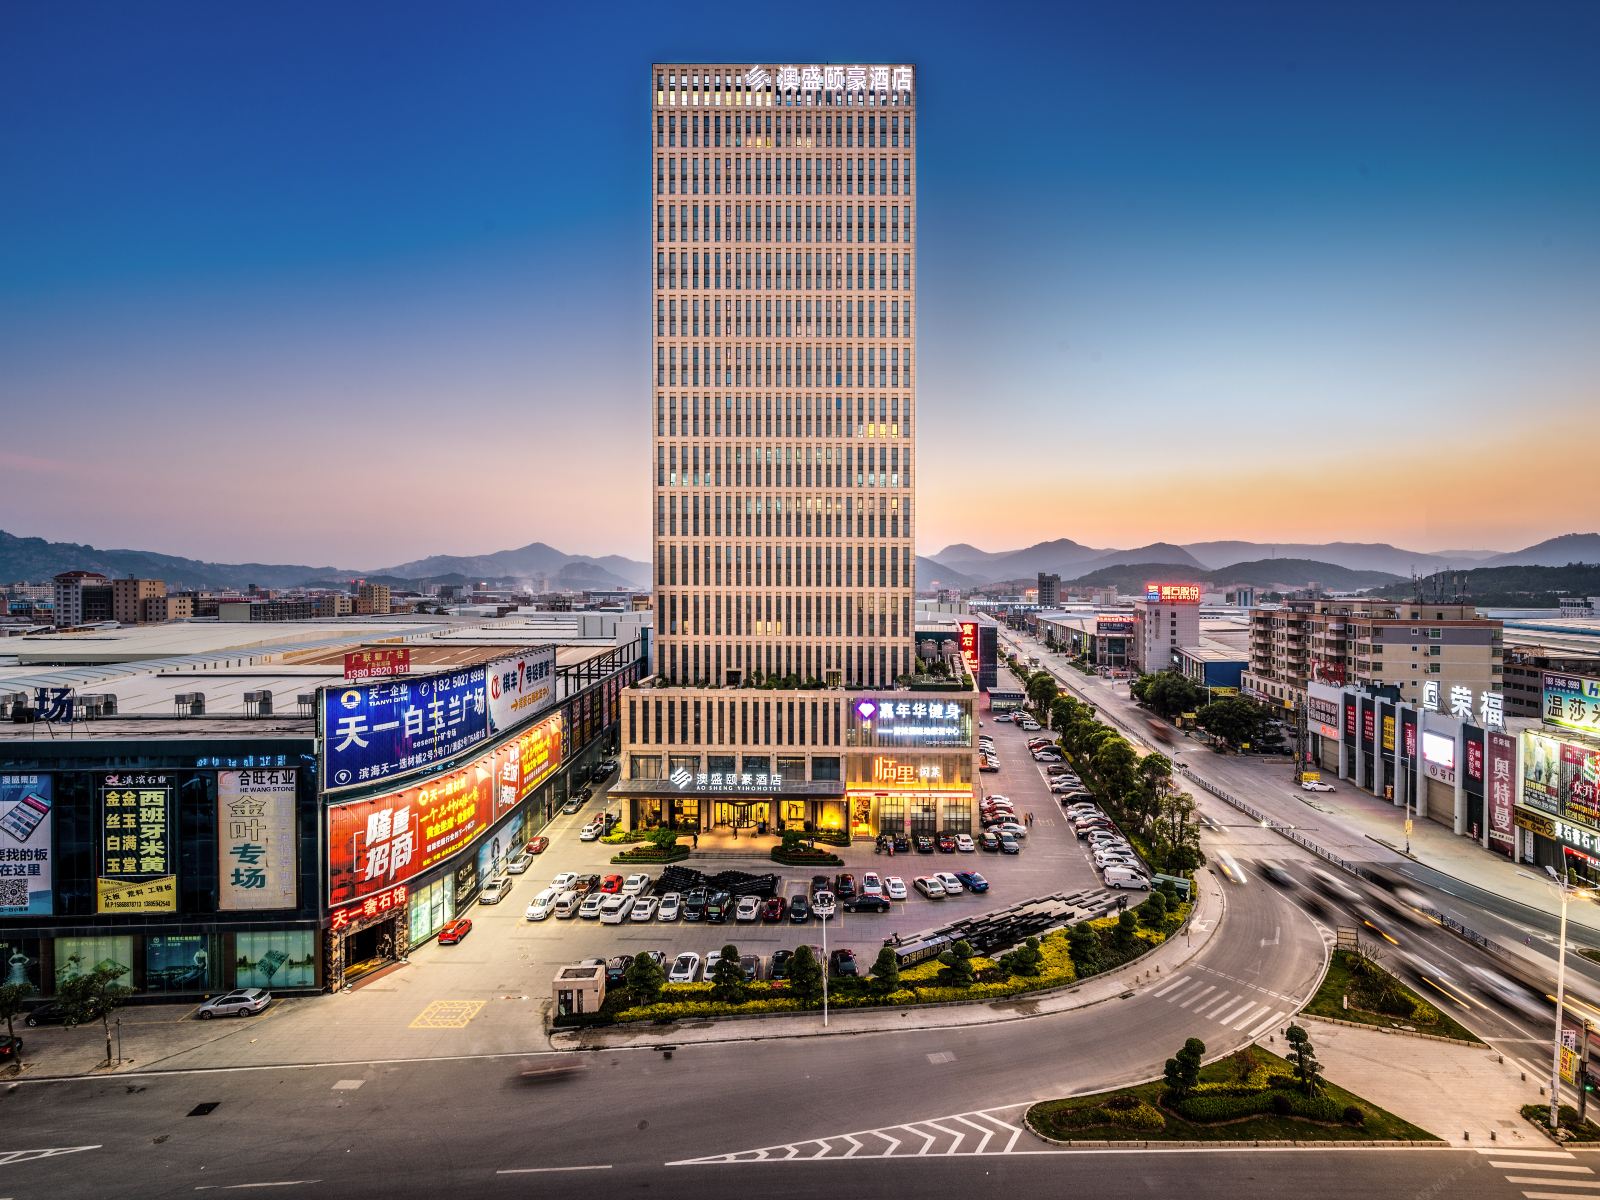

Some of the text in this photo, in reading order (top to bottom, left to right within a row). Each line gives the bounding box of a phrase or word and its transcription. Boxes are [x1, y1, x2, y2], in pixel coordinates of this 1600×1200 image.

[778, 65, 913, 92] 澳盛颐豪酒店
[346, 663, 409, 679] 1380 5920 191
[432, 680, 450, 693] 182
[34, 687, 74, 723] 场
[368, 683, 409, 700] 天一企业
[335, 687, 485, 753] 天一白玉兰广场
[879, 702, 961, 719] 嘉年华健身
[238, 770, 295, 786] 合旺石业
[696, 773, 782, 786] 澳盛颐豪酒店
[1493, 757, 1511, 832] 奥特曼
[106, 791, 121, 873] 金丝白玉
[122, 791, 137, 873] 金玉满堂
[139, 790, 166, 873] 西班牙米黄
[365, 831, 414, 881] 招商
[332, 886, 407, 929] 天一奢石馆
